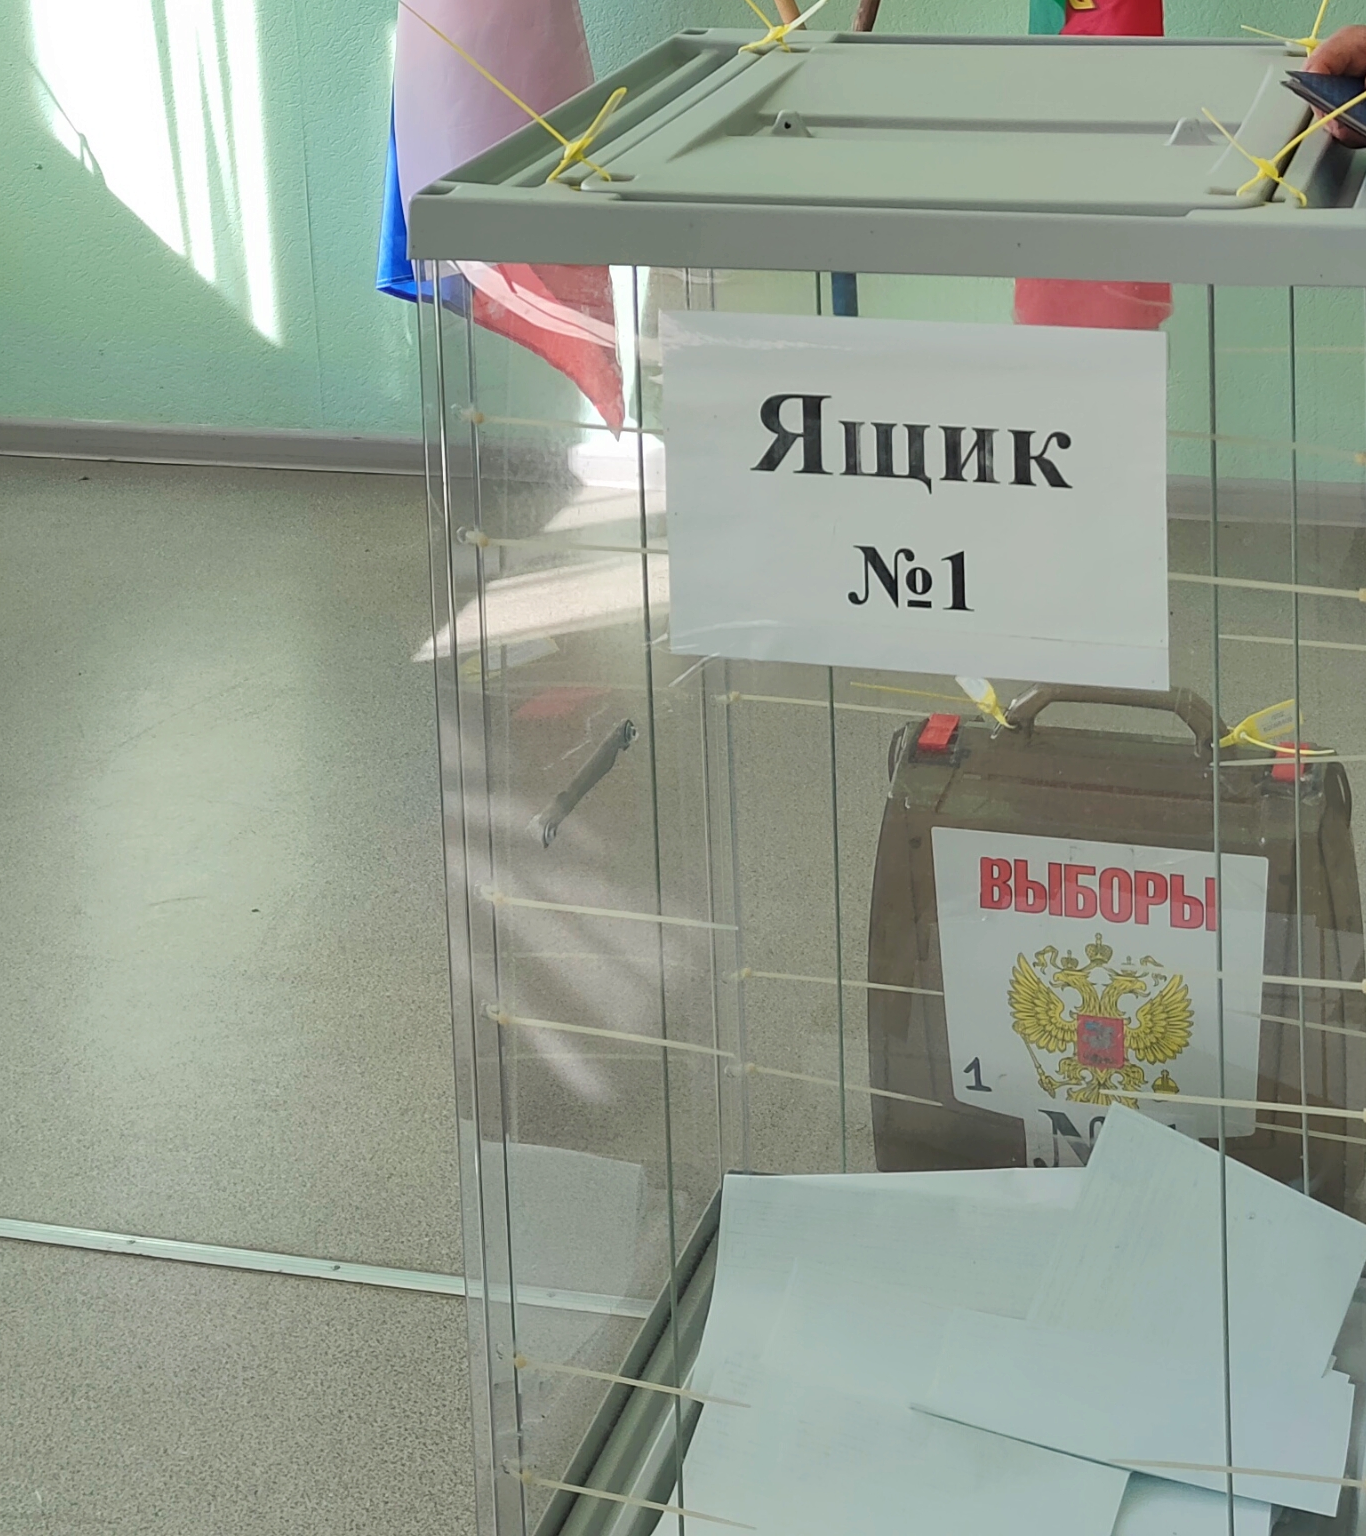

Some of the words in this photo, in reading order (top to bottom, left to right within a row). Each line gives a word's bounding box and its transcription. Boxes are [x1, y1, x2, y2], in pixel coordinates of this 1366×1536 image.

[750, 391, 1074, 495] Ящик
[847, 544, 976, 613] №1
[980, 856, 1218, 932] ВЫБОРЫ
[963, 1056, 992, 1092] 1
